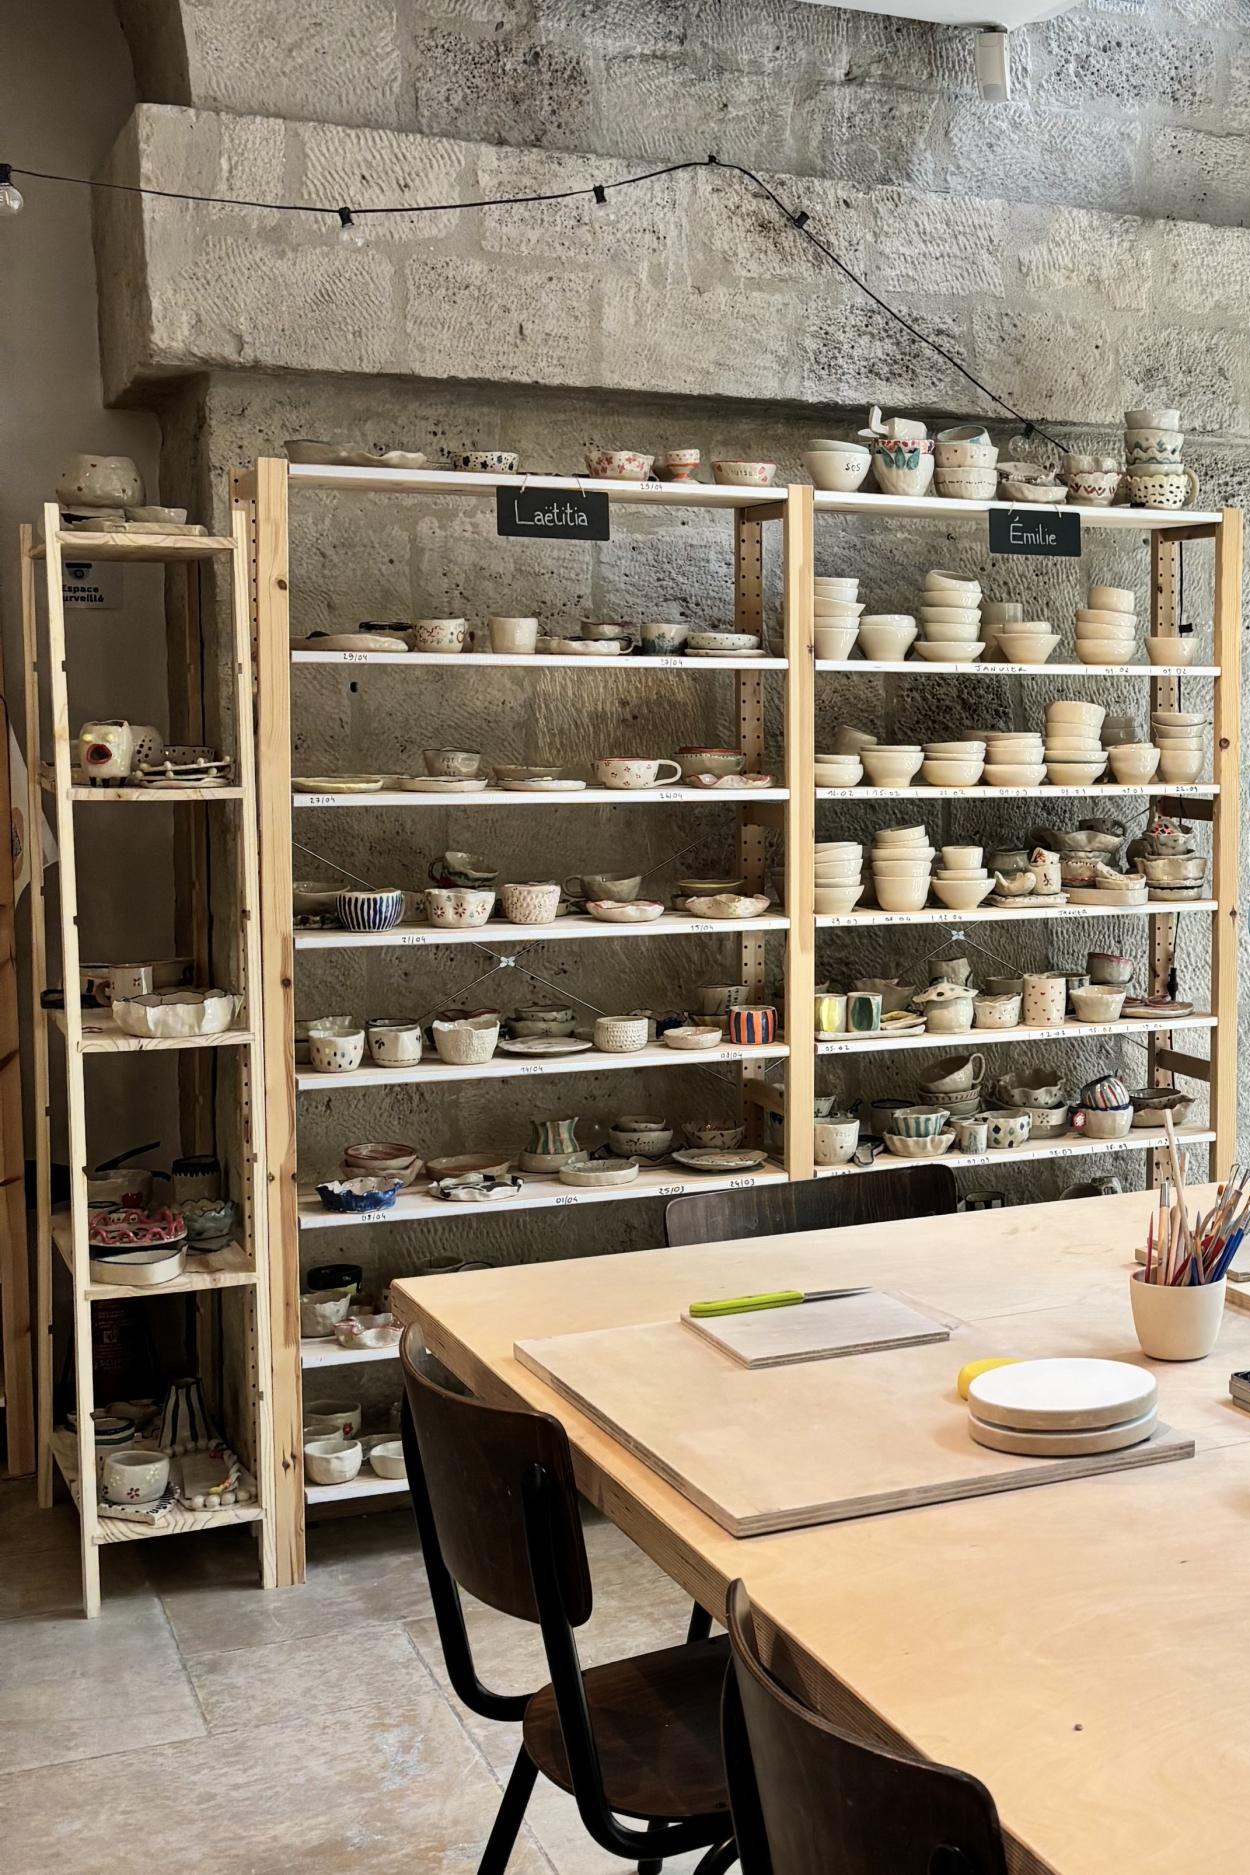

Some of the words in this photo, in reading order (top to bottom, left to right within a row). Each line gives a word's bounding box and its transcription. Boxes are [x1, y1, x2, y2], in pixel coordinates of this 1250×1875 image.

[514, 499, 588, 527] Laëtitia
[1010, 516, 1057, 545] Émilie
[63, 594, 104, 602] urveillé
